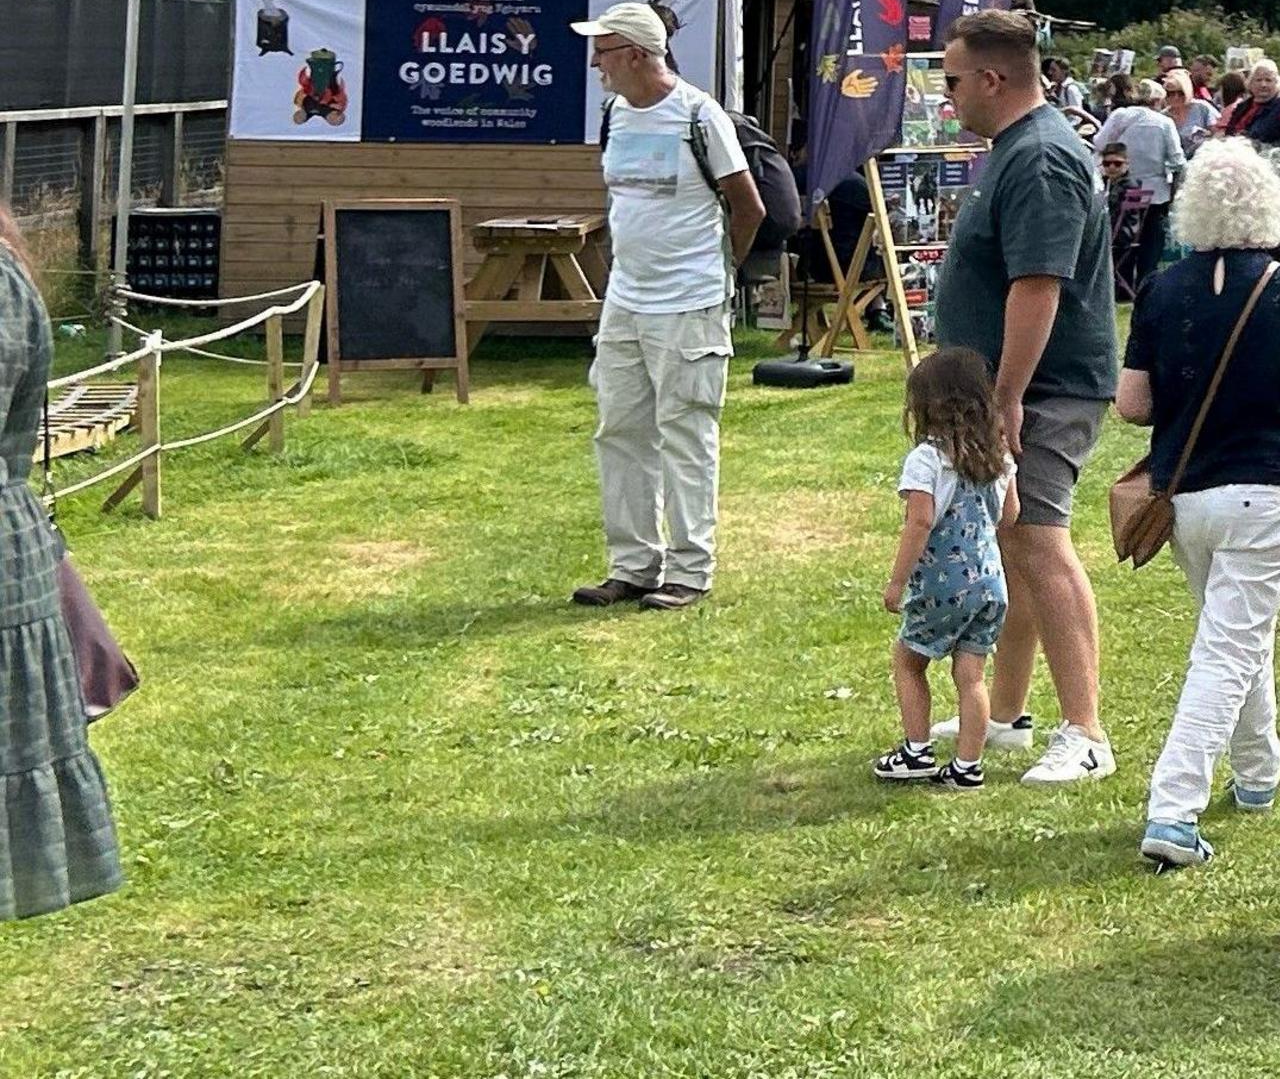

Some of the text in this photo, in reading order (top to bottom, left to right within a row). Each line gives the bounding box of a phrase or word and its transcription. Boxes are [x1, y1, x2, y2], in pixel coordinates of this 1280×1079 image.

[421, 31, 537, 55] LLAIS Y
[399, 61, 553, 86] GOEDWIG
